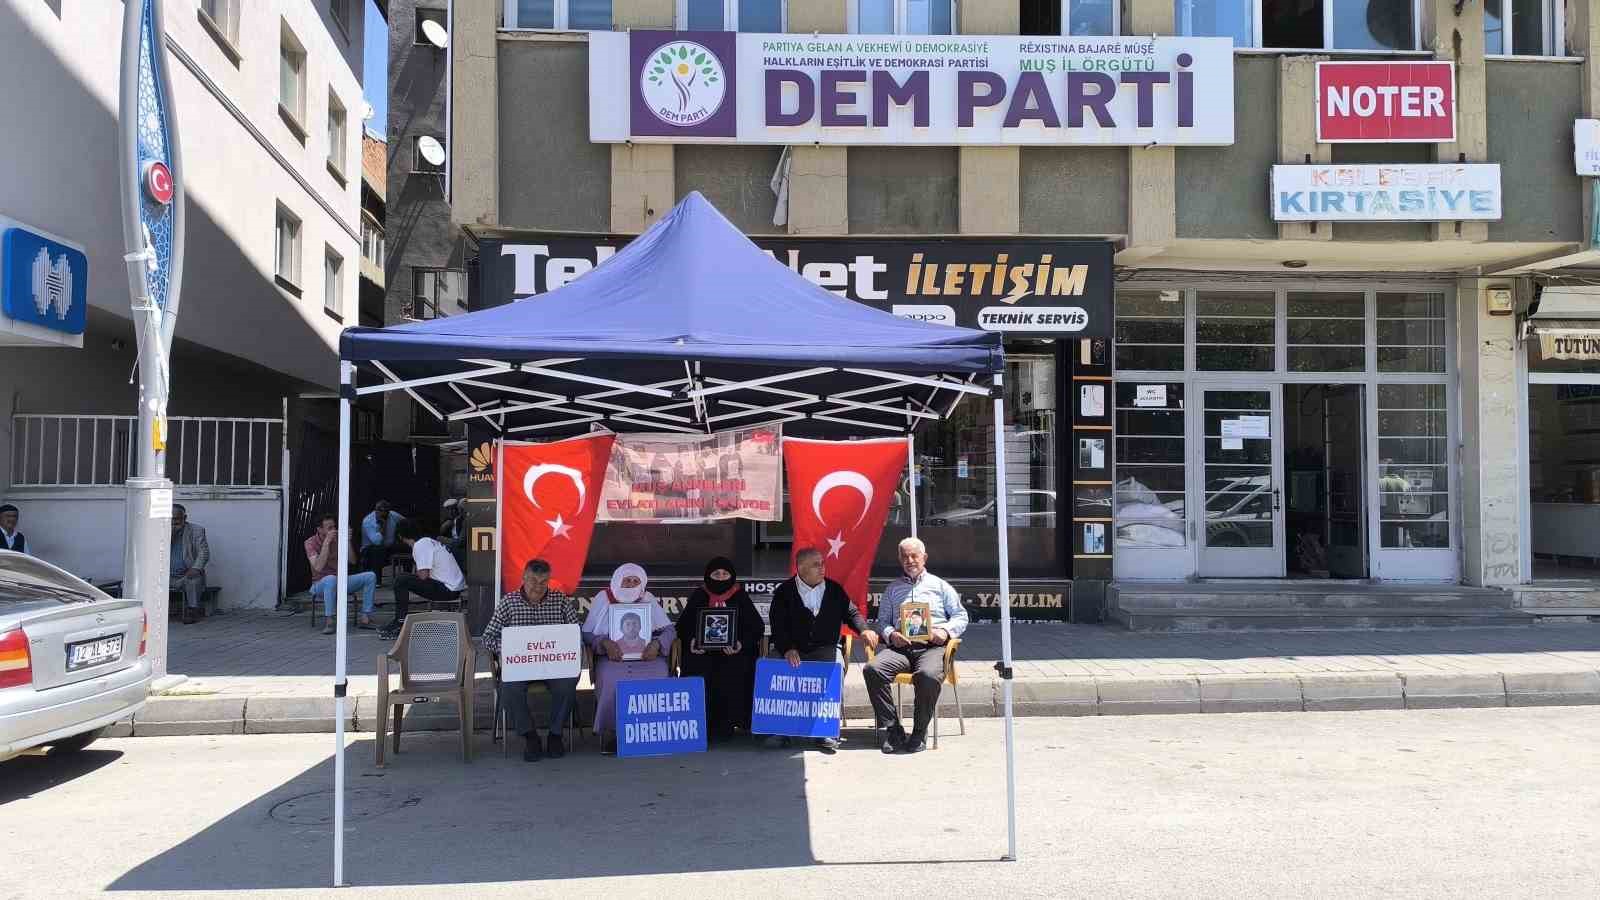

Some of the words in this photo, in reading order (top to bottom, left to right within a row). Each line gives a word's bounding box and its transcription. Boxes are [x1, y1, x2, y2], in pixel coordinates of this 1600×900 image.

[807, 42, 842, 52] GELAN
[847, 42, 853, 52] A
[763, 56, 825, 67] HALKLARIN
[827, 56, 866, 68] EŞİTLİK
[869, 58, 882, 67] VE
[884, 57, 944, 68] DEMOKRASİ
[948, 57, 989, 68] PARTİSİ
[1019, 58, 1056, 73] MUŞ
[1062, 57, 1077, 72] İL
[1082, 57, 1155, 72] ÖRGÜTÜ
[764, 70, 930, 129] DEM
[957, 53, 1194, 129] PARTİ
[1327, 86, 1447, 117] NOTER
[659, 107, 679, 121] DEM
[1280, 187, 1495, 213] KIRTASİYE
[905, 253, 1089, 304] İLETİŞİM
[982, 312, 1033, 325] TEKNİK
[1037, 312, 1085, 325] SERVİS
[977, 593, 1064, 608] YAZILIM
[527, 641, 556, 651] EVLAT
[770, 674, 795, 692] ARTIK
[797, 676, 822, 694] YETER
[627, 692, 690, 714] ANNELER
[754, 698, 810, 717] YAKAMIZDAN
[811, 697, 840, 723] DÜŞÜN
[625, 716, 699, 744] DİRENİYOR
